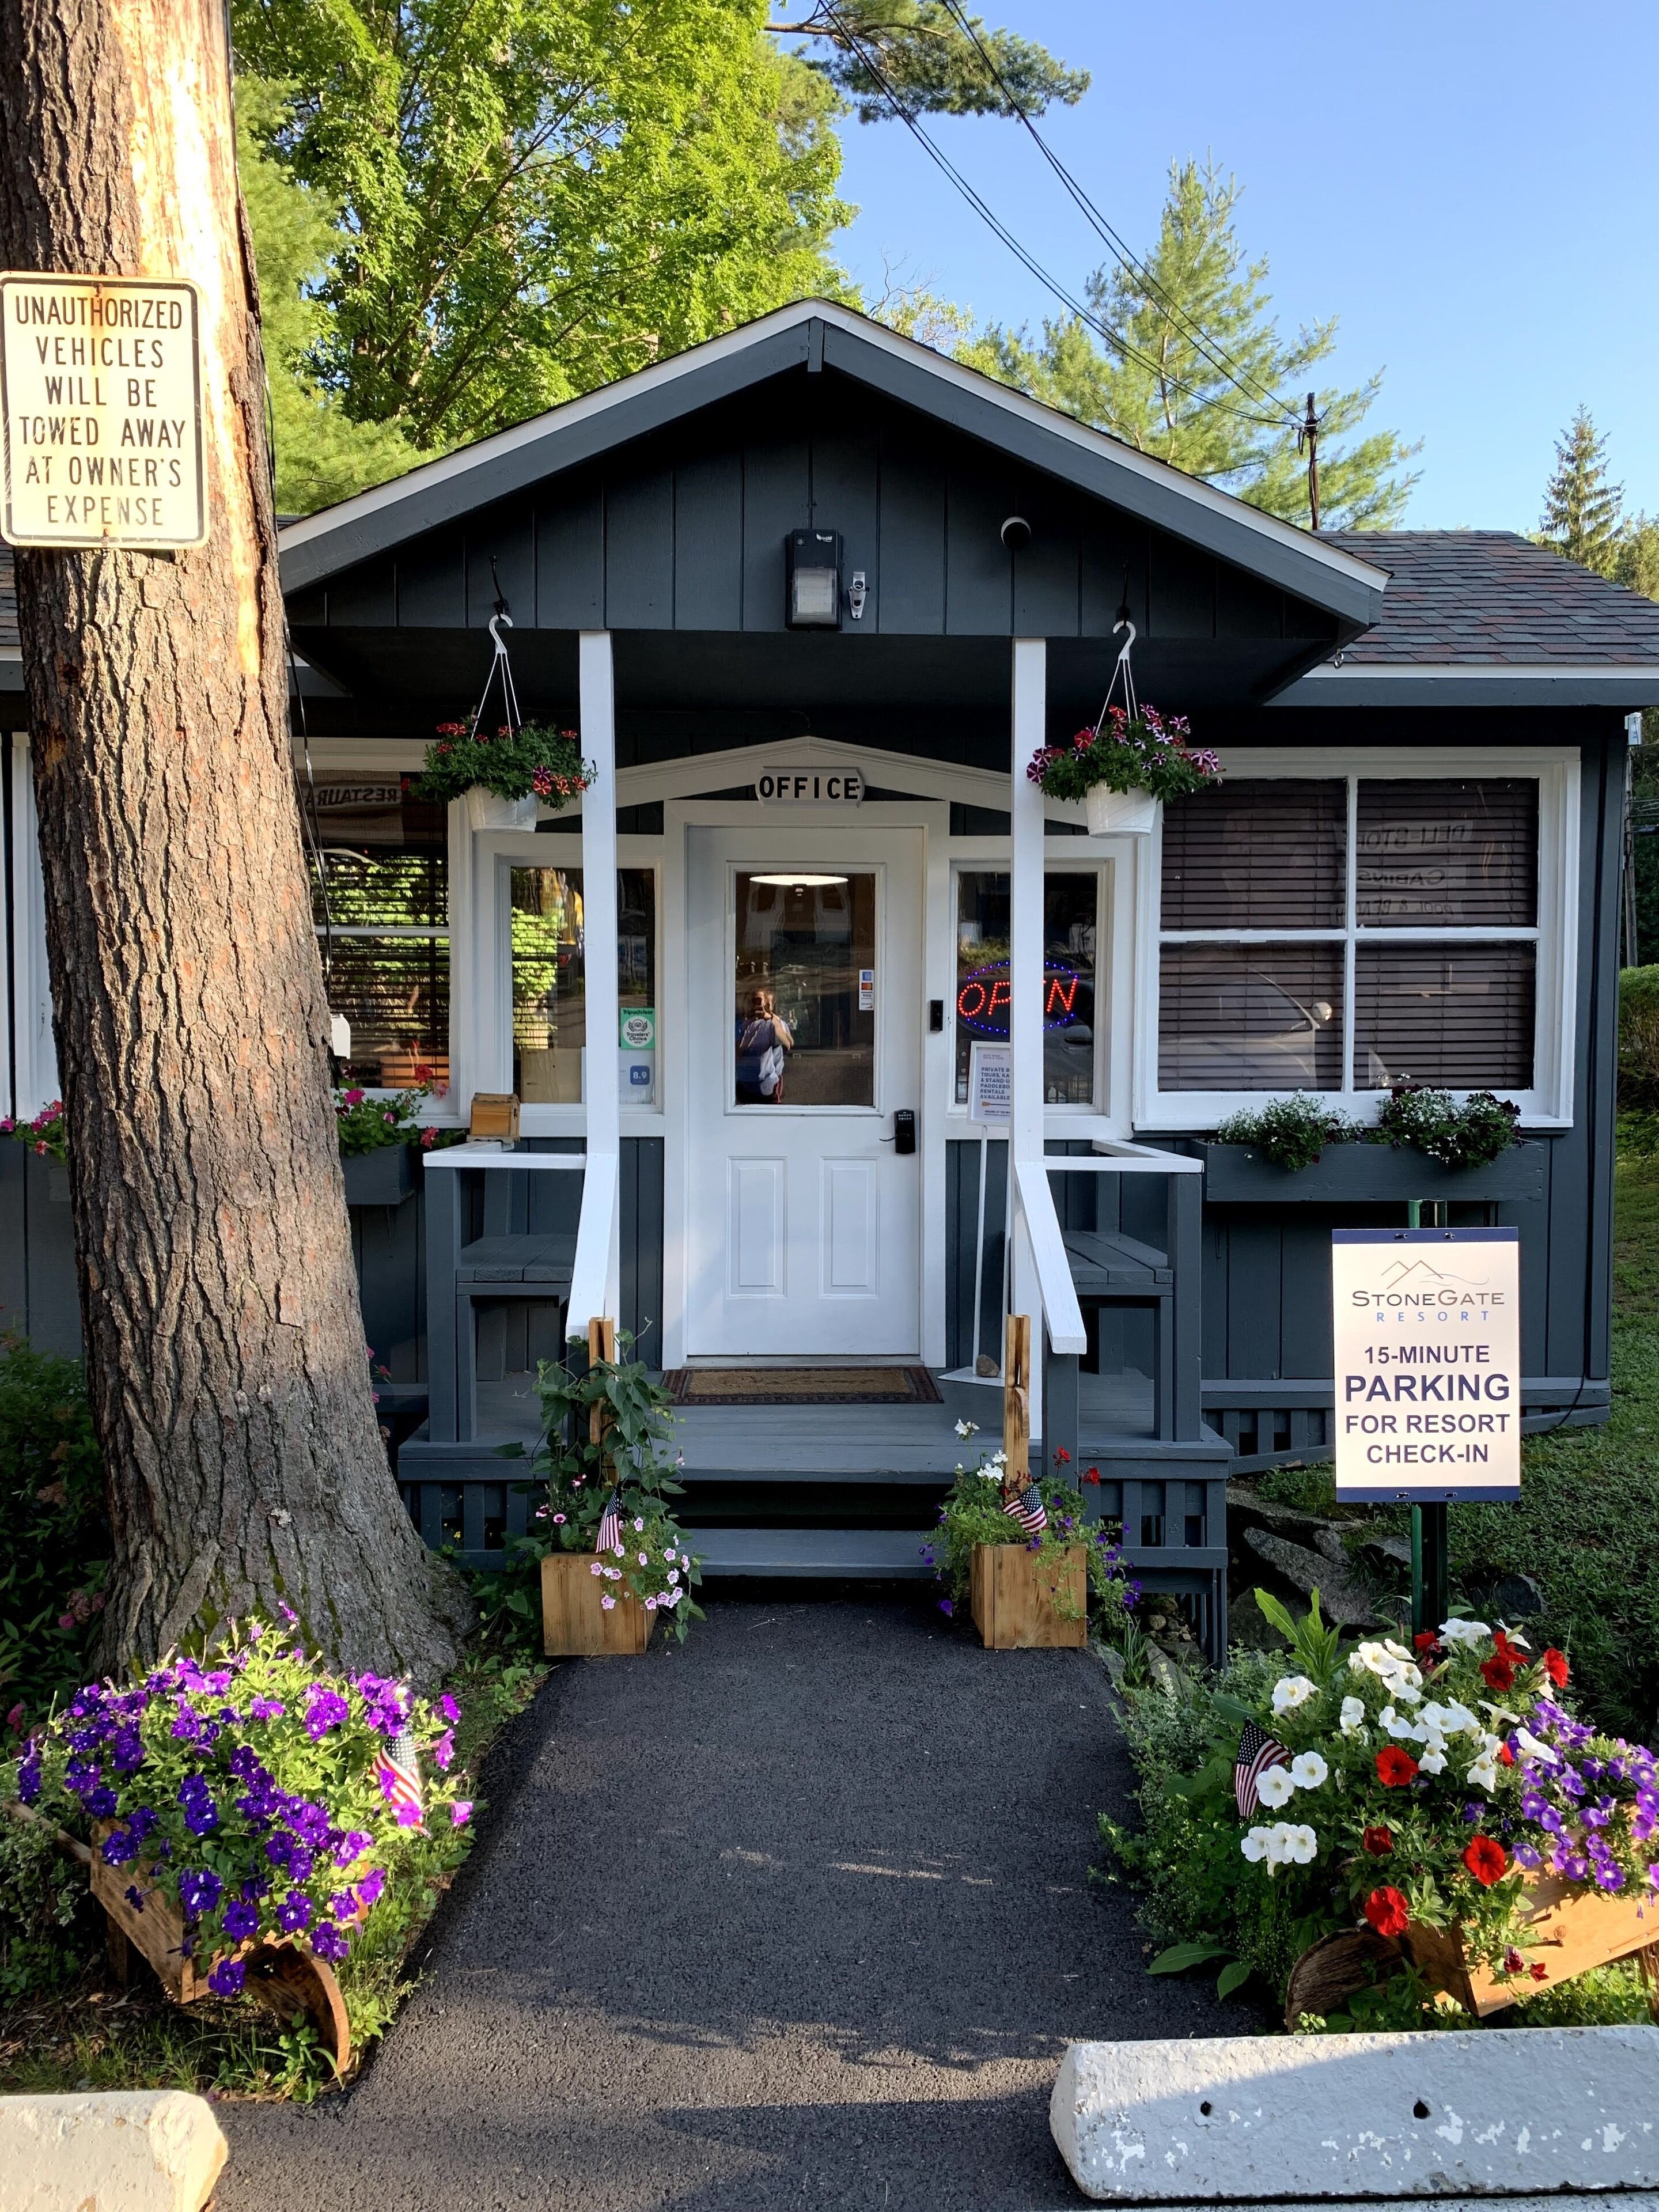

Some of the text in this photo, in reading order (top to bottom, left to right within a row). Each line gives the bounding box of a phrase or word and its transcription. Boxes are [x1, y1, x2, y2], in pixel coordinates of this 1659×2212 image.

[16, 295, 183, 329] UNAUTHORIZED
[35, 336, 164, 368] VEHICLES
[44, 376, 157, 408] WILL BE
[19, 416, 186, 449] TOWED AWAY
[25, 455, 181, 488] AT OWNER'S
[47, 495, 164, 526] EXPENSE
[759, 775, 858, 800] OFFICE
[958, 978, 1078, 1016] OPN
[633, 1071, 647, 1079] 8.9
[1376, 1310, 1489, 1323] RESORT
[1364, 1345, 1490, 1364] 15-MINUTE
[1345, 1373, 1510, 1403] PARKING
[1346, 1414, 1510, 1434] FOR RESORT
[1366, 1444, 1488, 1464] CHECK-IN
